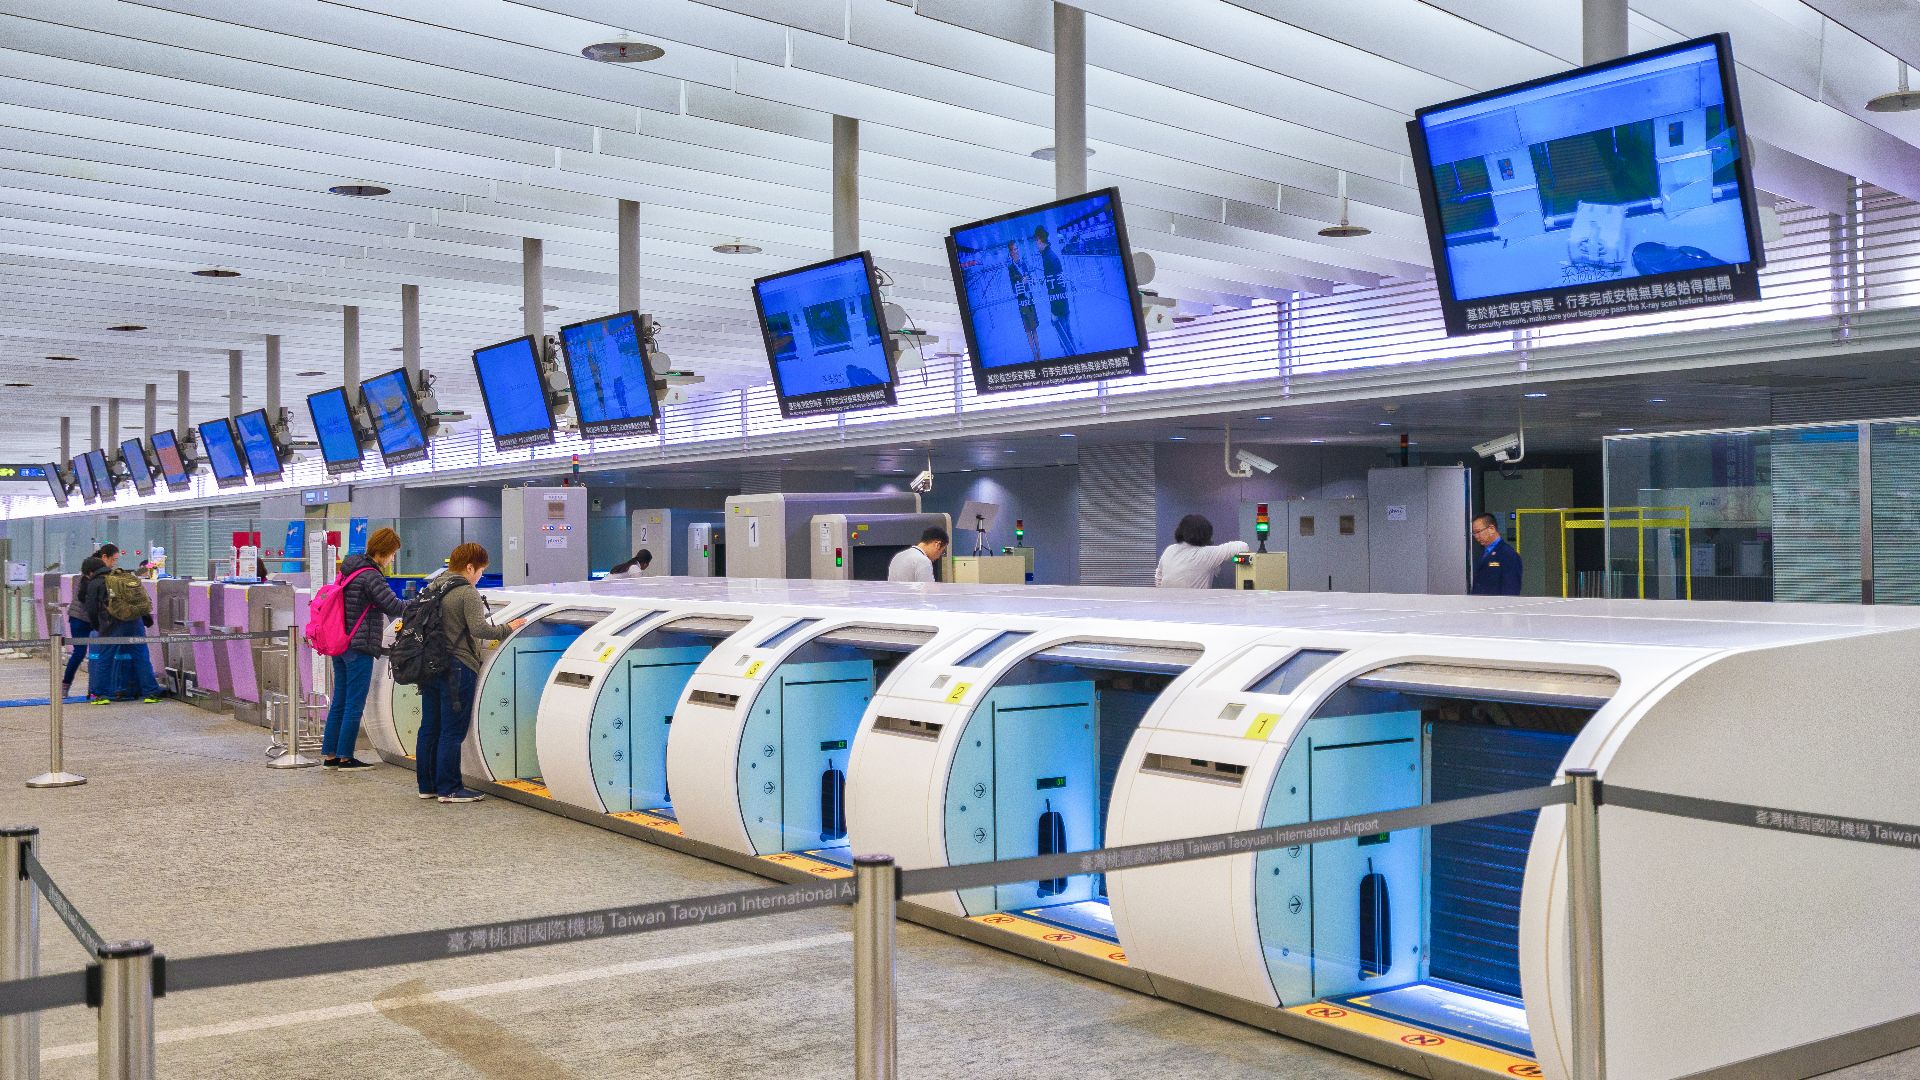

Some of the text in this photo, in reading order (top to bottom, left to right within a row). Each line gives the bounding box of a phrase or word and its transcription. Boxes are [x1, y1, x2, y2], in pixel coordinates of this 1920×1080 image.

[1467, 323, 1478, 331] For
[1478, 319, 1502, 329] security
[1529, 314, 1547, 323] make
[1562, 311, 1578, 320] your
[1579, 308, 1610, 318] baggage
[1610, 306, 1628, 314] pass
[1628, 303, 1640, 311] the
[1641, 301, 1660, 311] X-ray
[1661, 299, 1678, 308] scan
[1679, 296, 1704, 306] before
[641, 527, 648, 542] 2
[750, 521, 756, 543] 1
[951, 685, 965, 700] 2
[1257, 718, 1269, 734] 1
[1187, 839, 1226, 855] Taiwan
[1228, 834, 1273, 852] Taoyuan
[1276, 821, 1341, 843] International
[1343, 818, 1380, 835] Airport
[608, 908, 667, 930] Taiwan
[670, 900, 737, 922] Taoyuan
[741, 882, 837, 912] International
[840, 880, 856, 898] Ai
